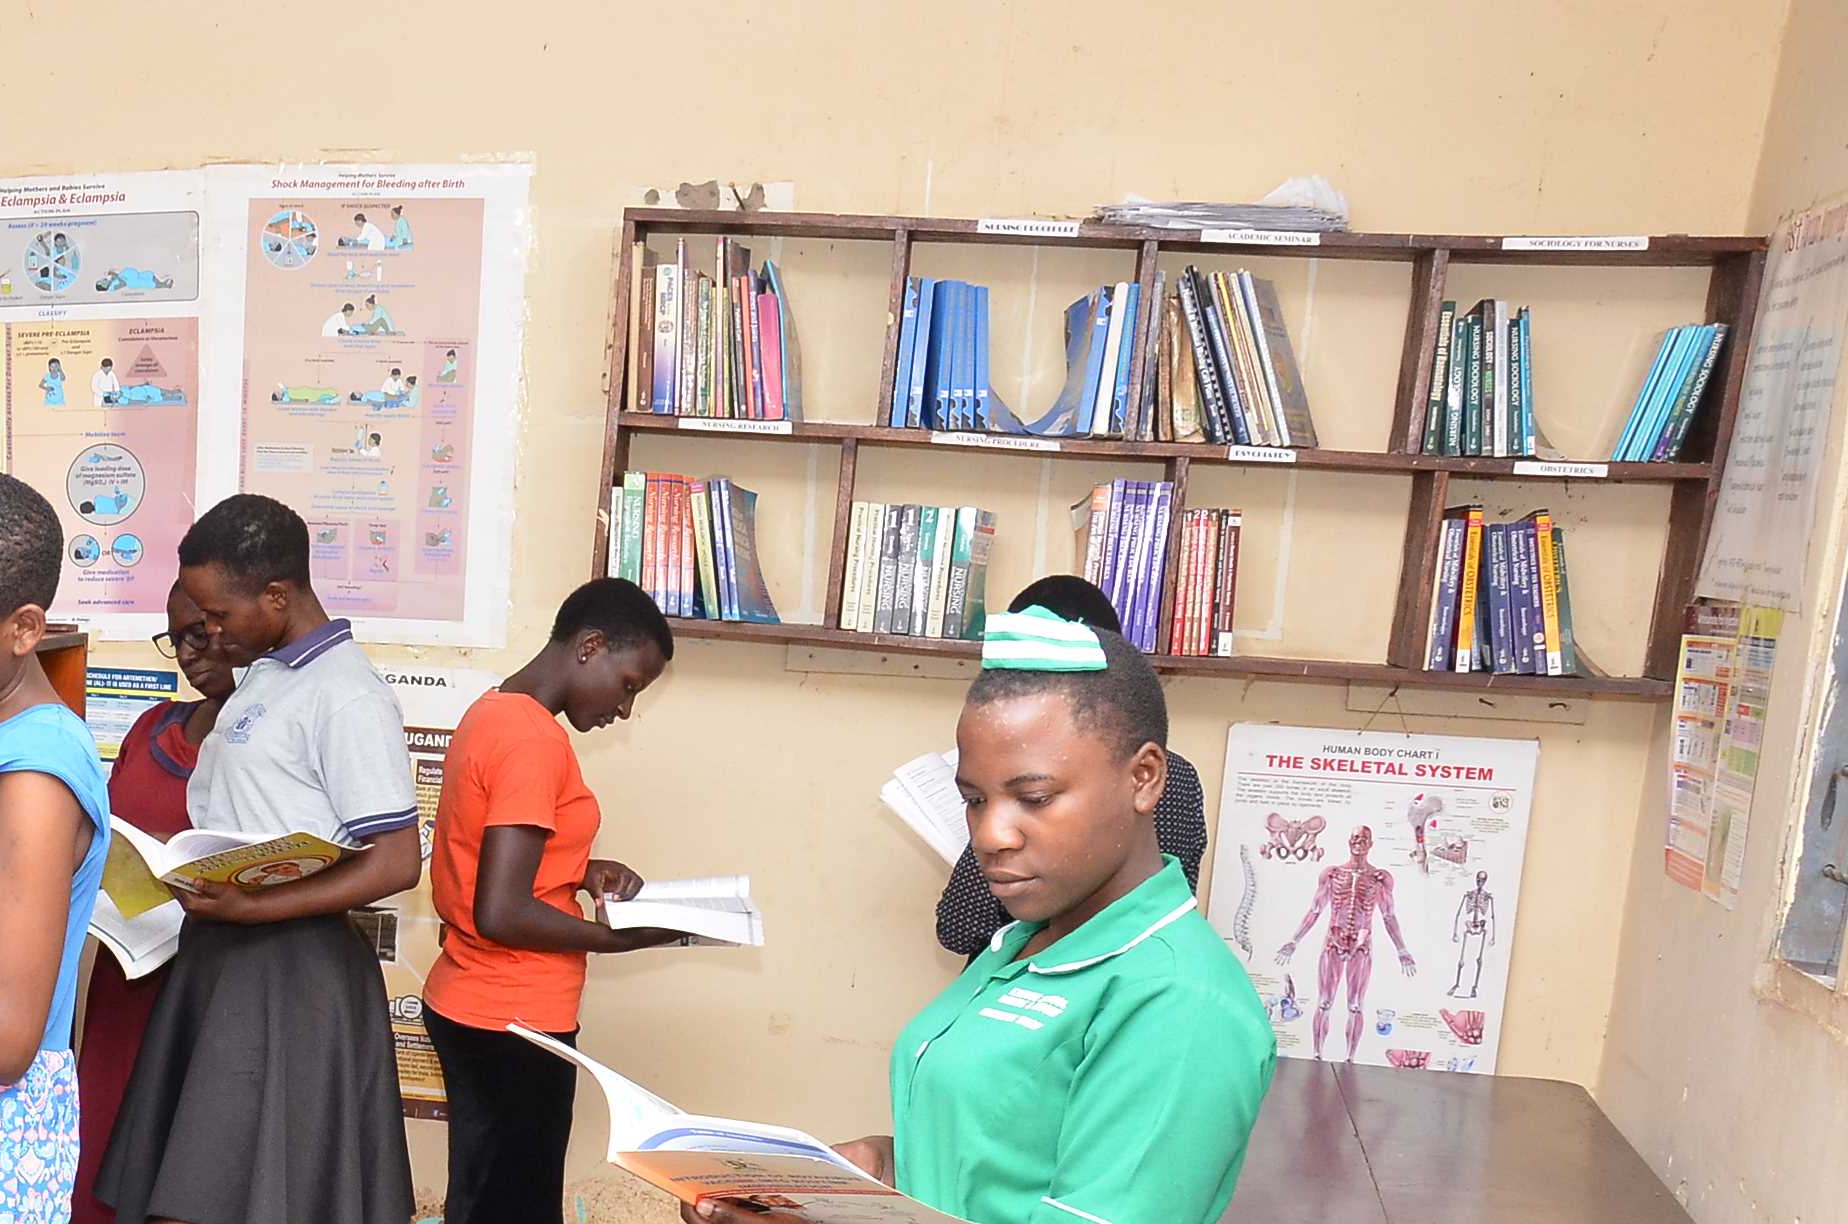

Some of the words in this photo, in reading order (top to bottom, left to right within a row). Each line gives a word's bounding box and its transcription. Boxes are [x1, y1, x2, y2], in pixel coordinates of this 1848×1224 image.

[271, 179, 297, 188] Shock
[299, 180, 359, 189] Management
[361, 179, 374, 187] for
[376, 179, 415, 190] Bleeding
[418, 179, 440, 187] after
[442, 179, 464, 187] Birth
[58, 193, 67, 203] &
[69, 191, 125, 205] Eclampsia
[1472, 325, 1480, 359] NURSING
[1703, 331, 1724, 368] NURSING
[1470, 361, 1479, 405] SOCIOLOGY
[1511, 362, 1519, 405] SOCIOLOGY
[1685, 367, 1709, 414] SOCIOLOGY
[1540, 465, 1593, 473] OBSTETRICS
[949, 567, 963, 614] NURSING
[385, 674, 447, 687] GANDA
[404, 733, 452, 748] UGAN
[1322, 745, 1360, 755] HUMAN
[1364, 747, 1393, 757] BODY
[1396, 749, 1433, 759] CHART
[1265, 754, 1303, 768] THE
[1310, 757, 1408, 775] SKELETAL
[1414, 763, 1493, 780] SYSTEM
